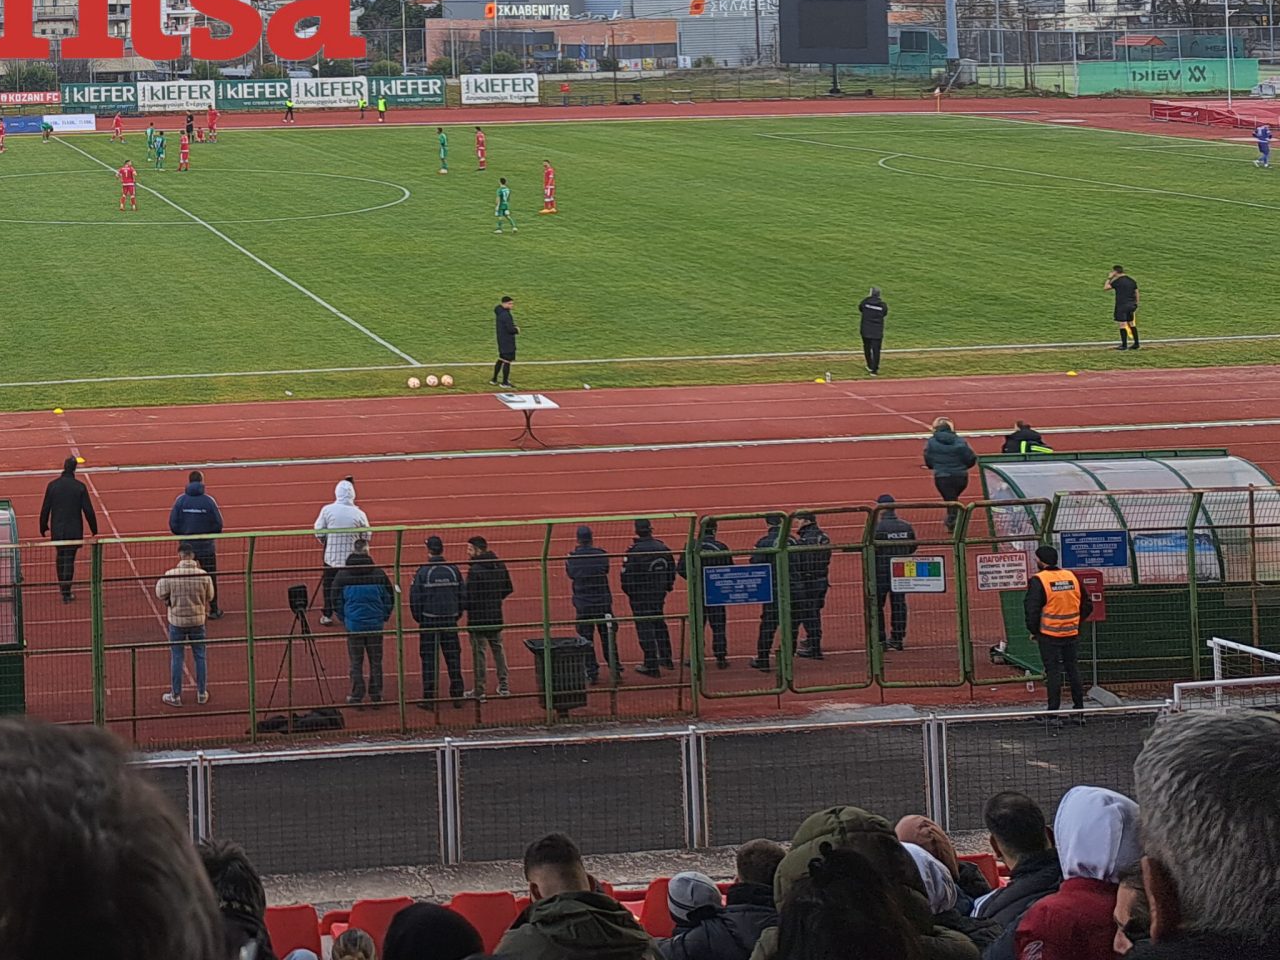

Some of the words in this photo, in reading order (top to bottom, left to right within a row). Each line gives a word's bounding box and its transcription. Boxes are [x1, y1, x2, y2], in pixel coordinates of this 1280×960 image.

[498, 4, 569, 16] ΣΚΛΑΒΕΝΙΤΗΣ
[9, 93, 43, 102] KOZANI
[46, 92, 59, 102] FC
[979, 554, 1025, 563] ΑΠΑΓΟΡΕΥΕΤΑΙ
